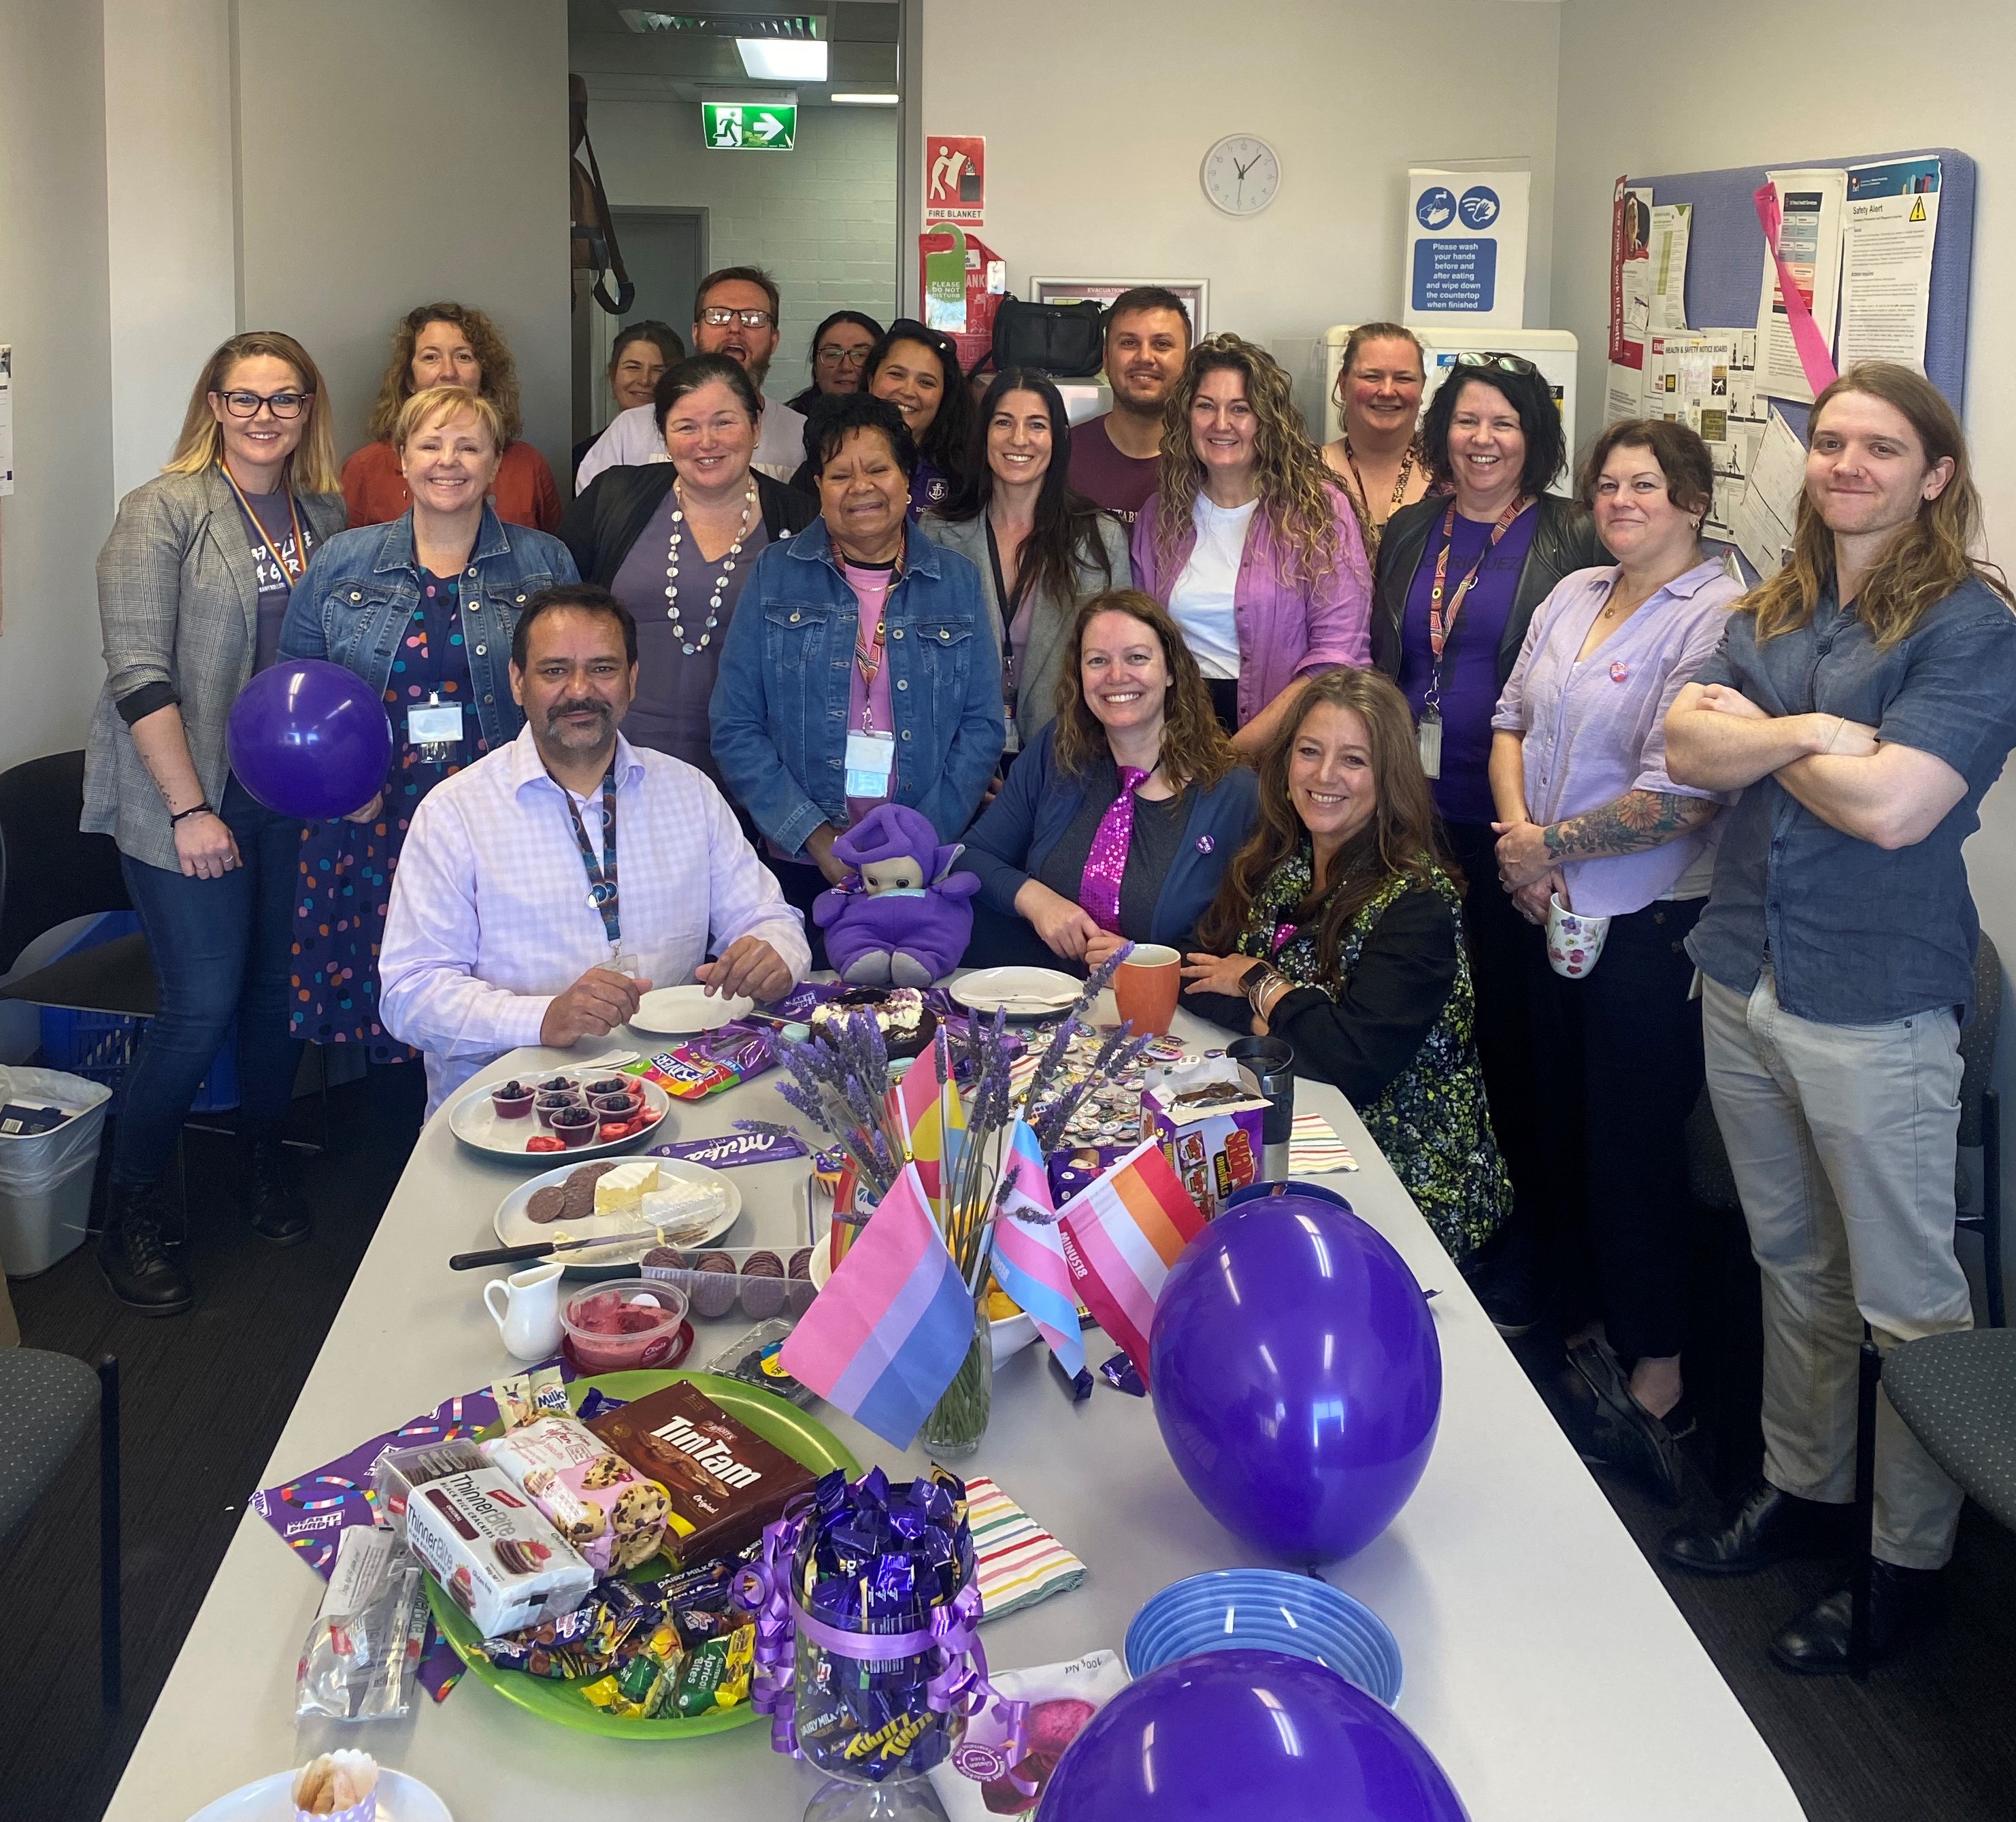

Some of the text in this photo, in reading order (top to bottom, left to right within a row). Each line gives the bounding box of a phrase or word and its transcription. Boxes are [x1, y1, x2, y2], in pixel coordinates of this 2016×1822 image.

[1616, 208, 1622, 226] we
[1853, 204, 1883, 215] Safety Alert
[1452, 273, 1474, 281] eating
[1442, 282, 1459, 291] wipe
[1215, 1156, 1232, 1196] ORIGINALS
[1060, 1231, 1087, 1278] MINUS18
[538, 1390, 567, 1408] Milky
[440, 1482, 495, 1539] BLACK RICE CRACKERS
[693, 1495, 719, 1514] Original
[288, 1514, 339, 1526] WEAR IT
[289, 1520, 342, 1531] PURPLE
[550, 1532, 568, 1548] Gluten
[472, 1570, 484, 1585] Gluten
[657, 1565, 708, 1589] DAIRY MILK
[687, 1656, 704, 1685] Bites
[713, 1657, 723, 1676] GLUTEN
